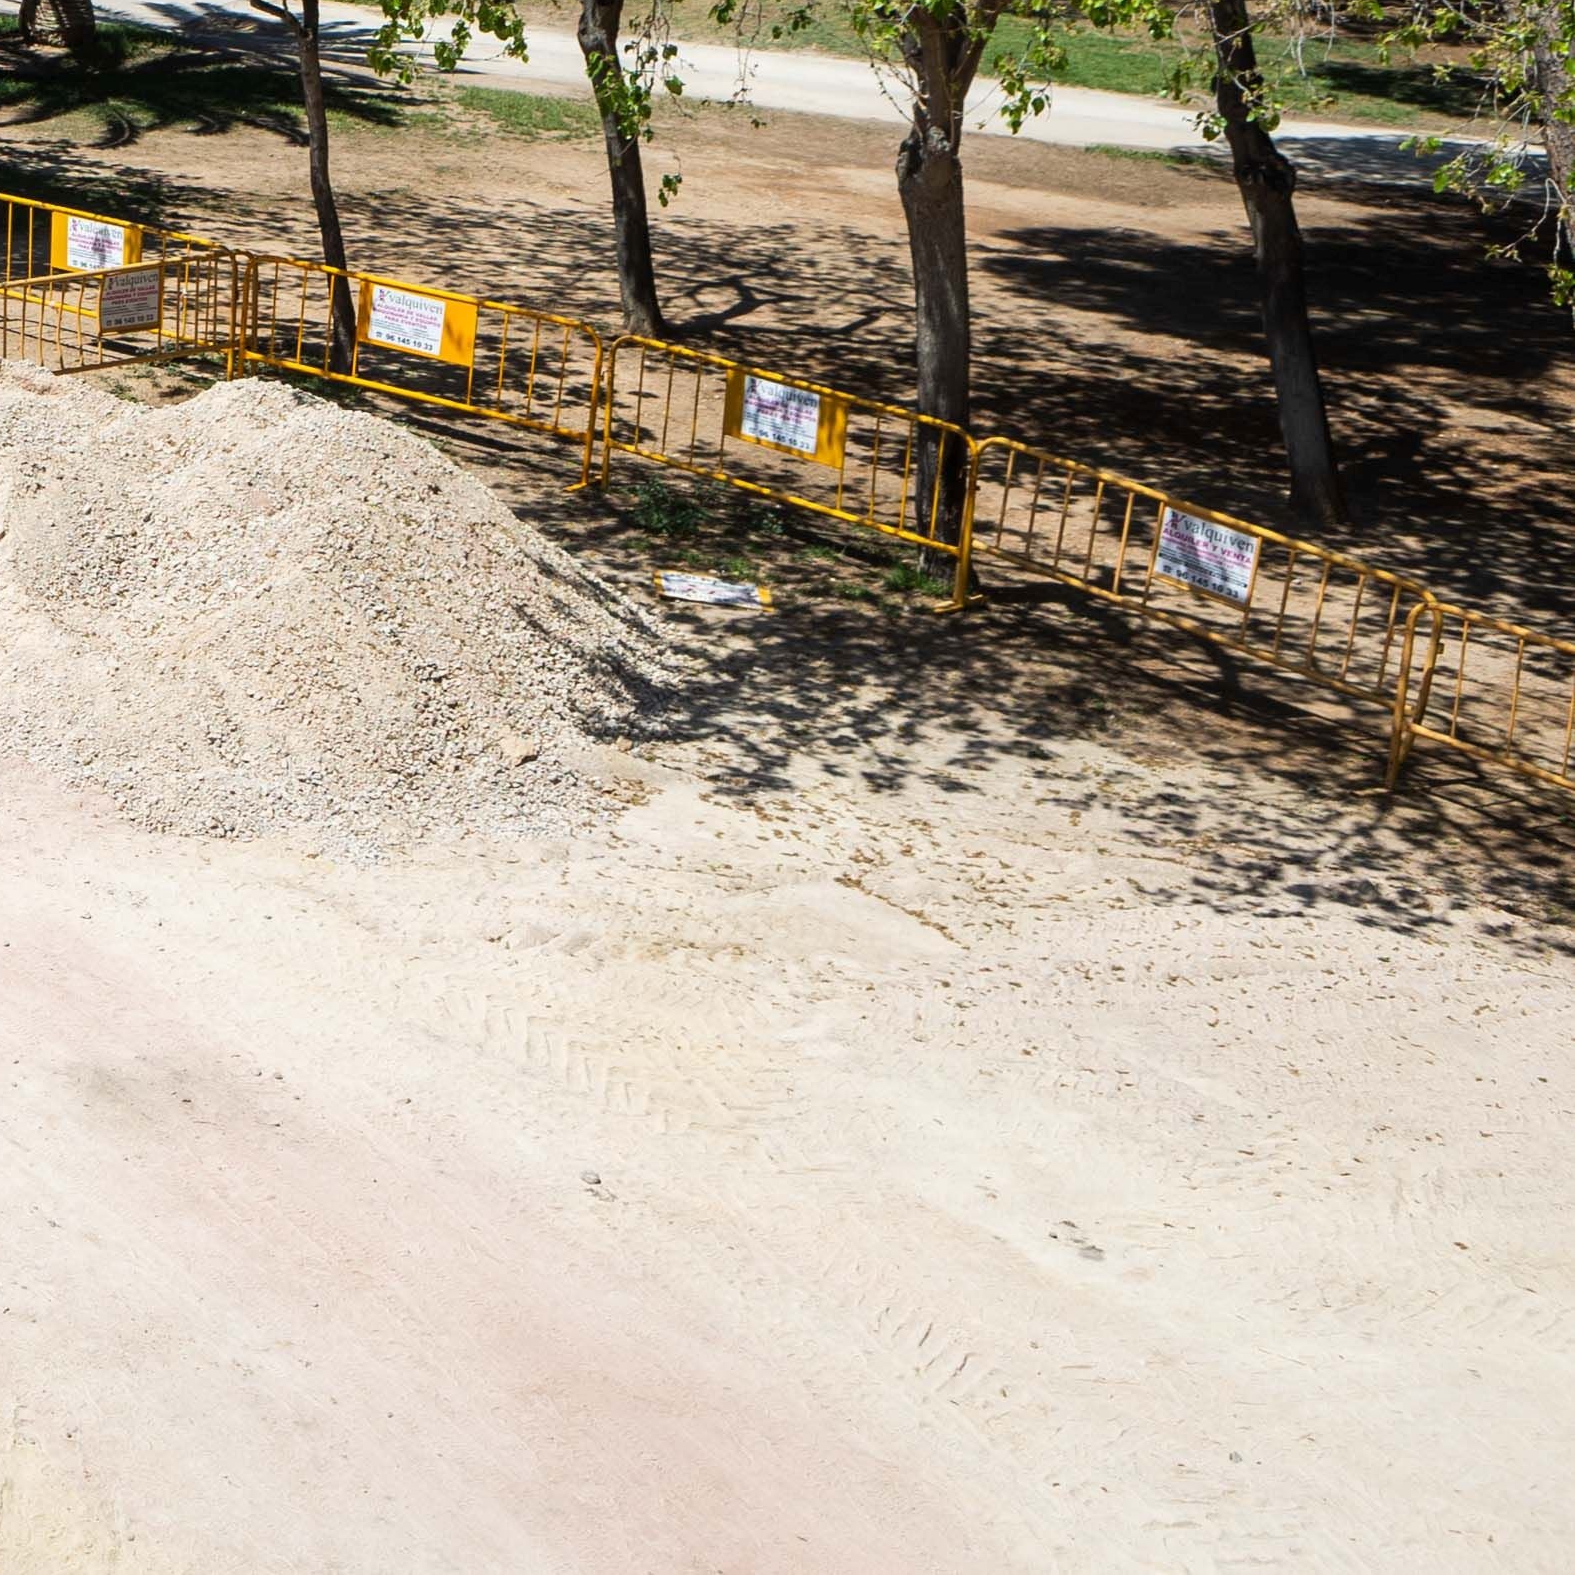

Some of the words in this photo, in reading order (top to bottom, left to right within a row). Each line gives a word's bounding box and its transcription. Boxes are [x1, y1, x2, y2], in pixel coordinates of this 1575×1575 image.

[389, 294, 443, 315] valquiven
[398, 336, 410, 345] 145
[1163, 528, 1209, 549] ALQUILER
[1221, 547, 1252, 564] VENTA
[1184, 520, 1254, 554] valquiven
[1192, 575, 1209, 588] 145
